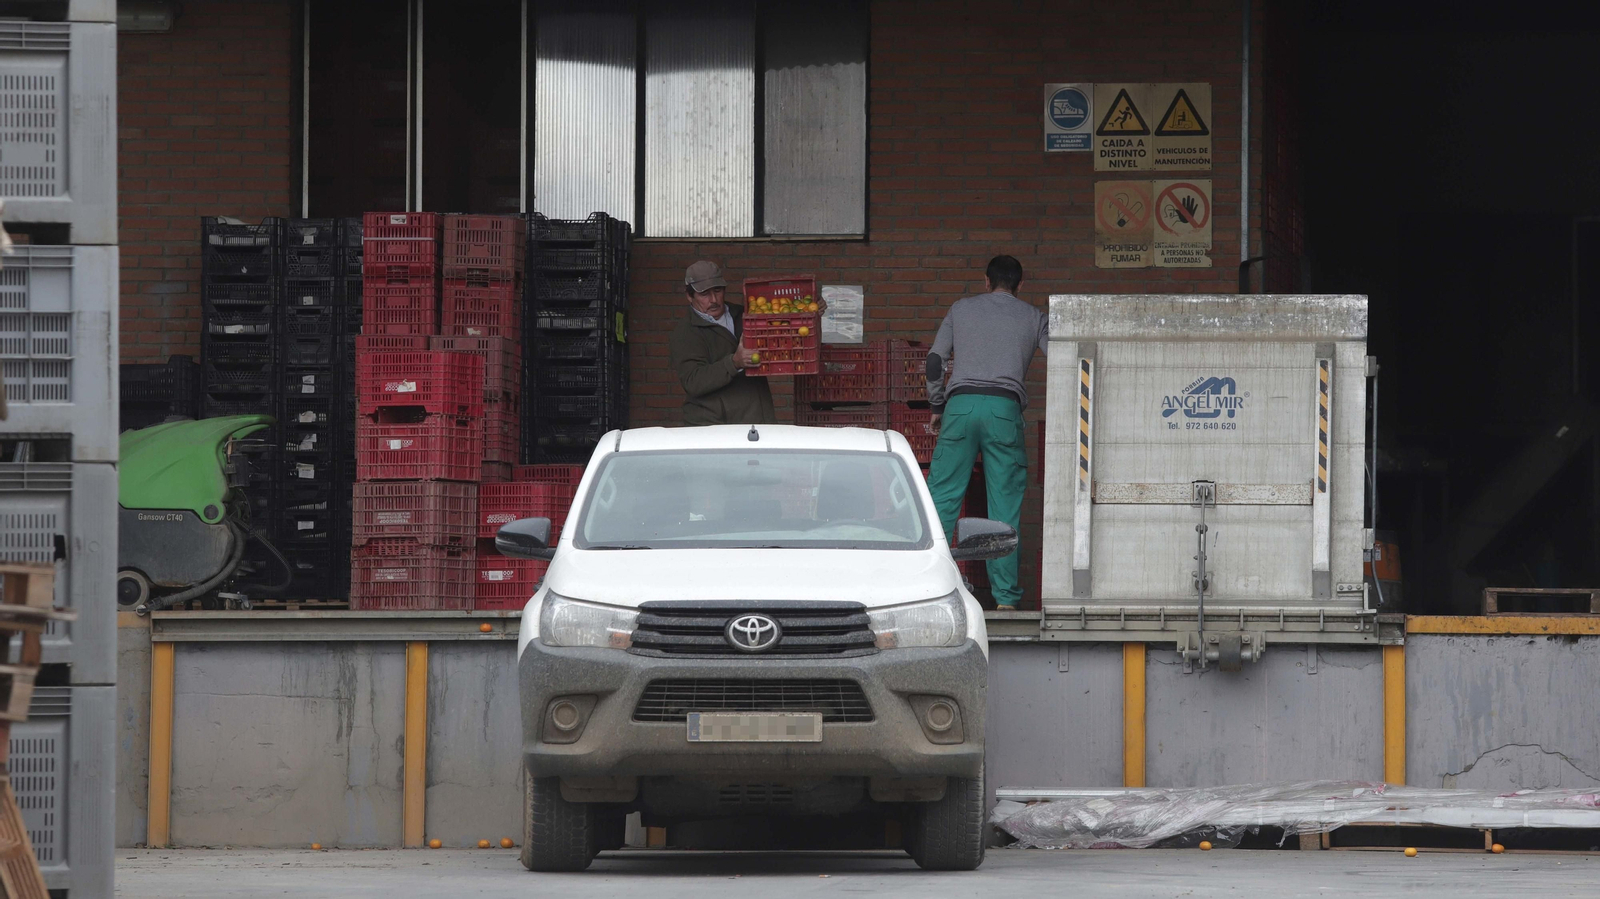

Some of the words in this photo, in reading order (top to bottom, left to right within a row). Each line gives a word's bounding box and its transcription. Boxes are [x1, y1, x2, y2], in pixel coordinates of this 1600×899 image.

[1102, 139, 1133, 148] CAIDA
[1137, 139, 1145, 148] A
[1100, 149, 1146, 158] DISTINTO
[1108, 159, 1138, 168] NIVEL
[1154, 156, 1210, 165] MANUTENCIÓN
[1103, 244, 1148, 252] PROHIBIDO
[1110, 254, 1141, 262] FUMAR
[1215, 396, 1244, 409] MIR
[1167, 421, 1180, 430] Tel.
[1185, 422, 1201, 430] 972
[1203, 422, 1219, 430] 640
[1221, 422, 1237, 430] 620
[138, 512, 165, 521] Gansow
[166, 513, 184, 522] CT40
